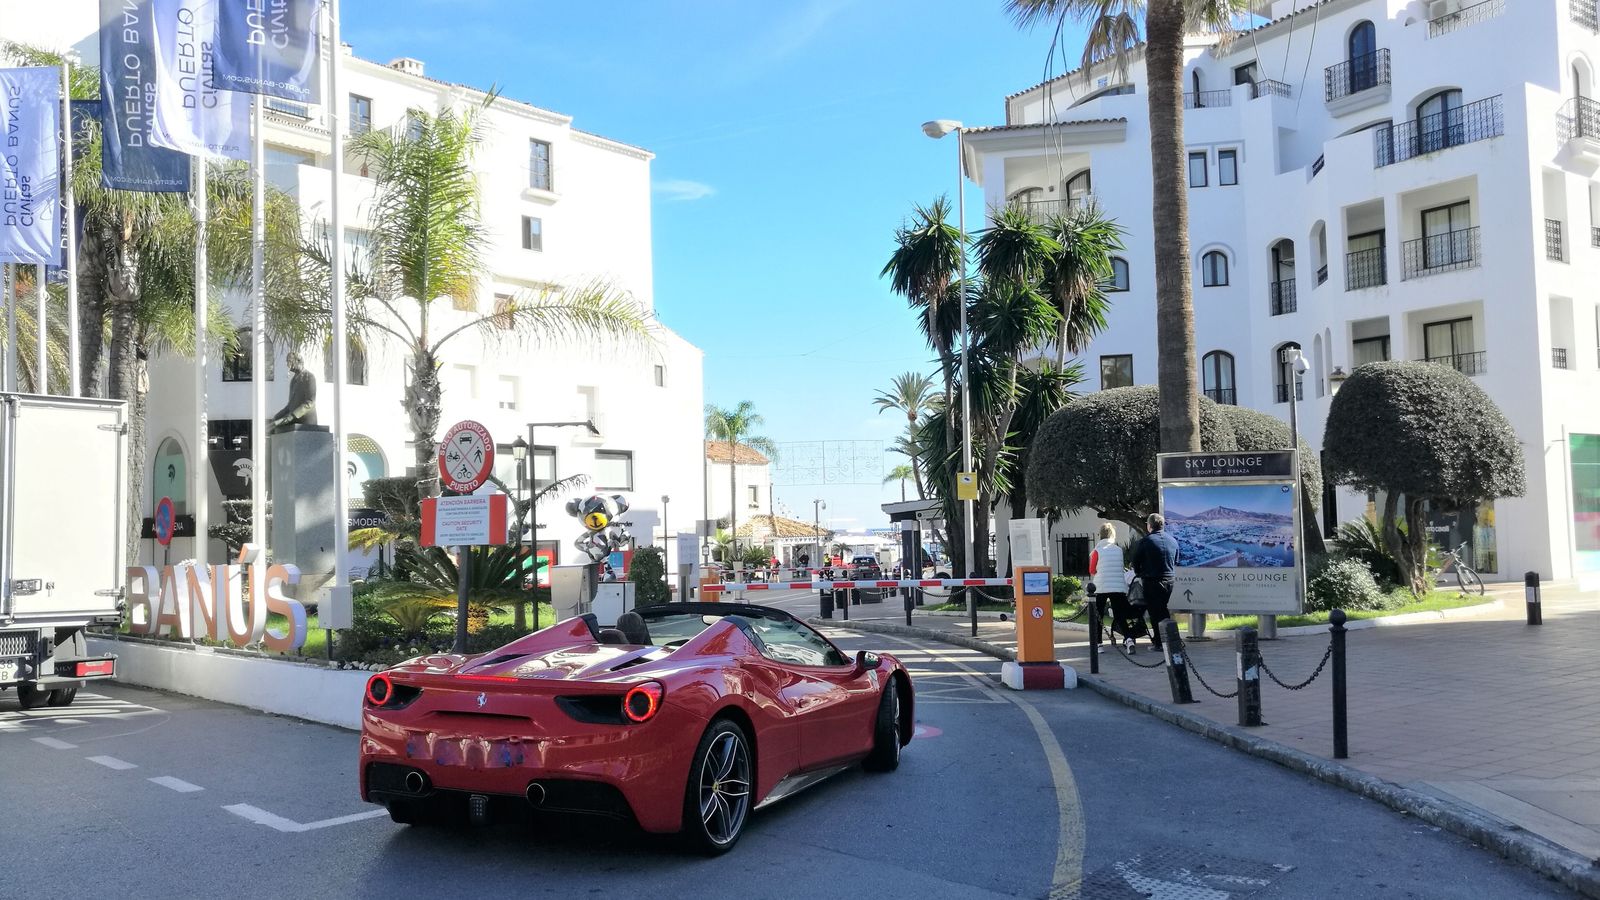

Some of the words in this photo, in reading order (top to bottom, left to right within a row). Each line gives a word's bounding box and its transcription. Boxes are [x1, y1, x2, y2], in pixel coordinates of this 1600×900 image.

[440, 431, 453, 456] SOLO
[453, 421, 491, 452] AUTORIZADO
[1185, 459, 1207, 469] SKY
[1212, 457, 1263, 468] LOUNGE
[450, 480, 479, 491] PUERTO
[1217, 573, 1238, 581] SKY
[1242, 573, 1288, 582] LOUNGE
[128, 543, 306, 651] BANÚS
